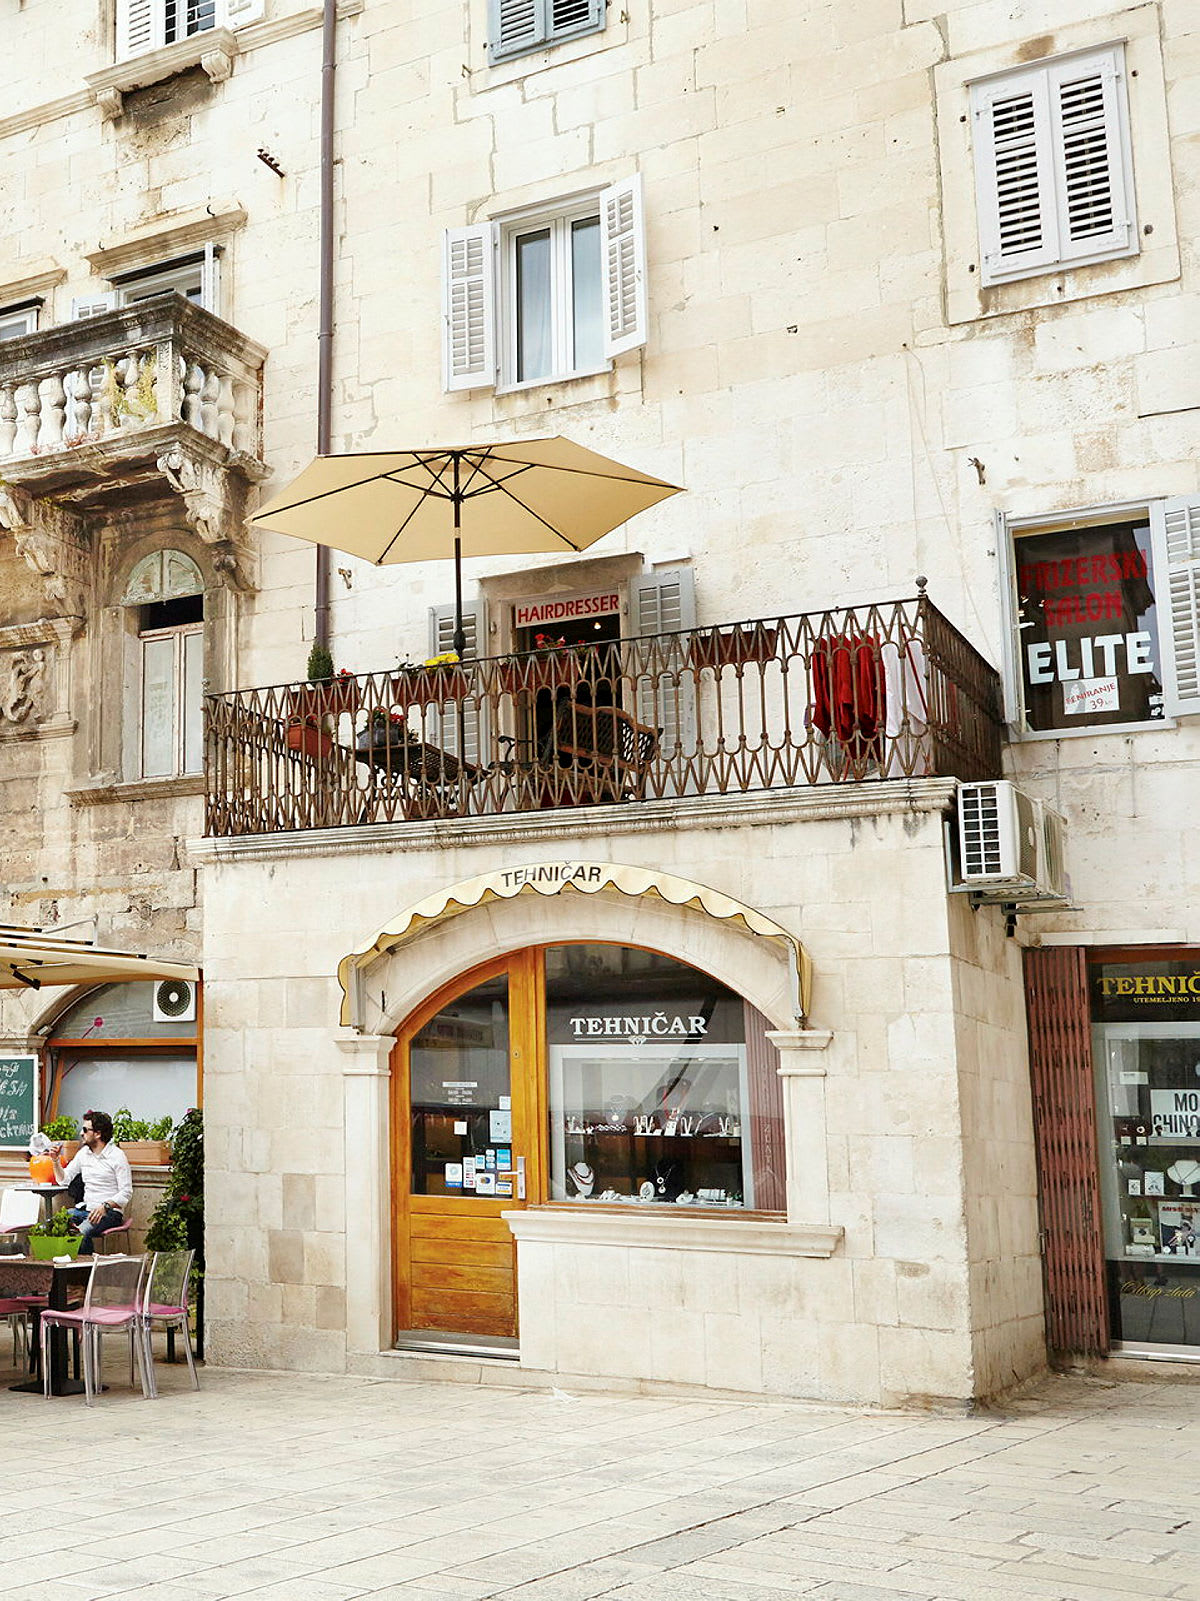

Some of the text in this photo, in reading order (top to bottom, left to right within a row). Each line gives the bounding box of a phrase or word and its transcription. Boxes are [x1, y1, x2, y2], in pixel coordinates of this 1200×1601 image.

[1020, 549, 1148, 594] FRIZERSKI
[517, 594, 619, 623] HAIRDRESSER
[1043, 590, 1123, 628] SALON
[1027, 631, 1154, 685] ELITE
[501, 860, 602, 887] TEHNIČAR
[1096, 971, 1200, 995] TEHNIČ
[570, 1012, 708, 1035] TEHNIČAR
